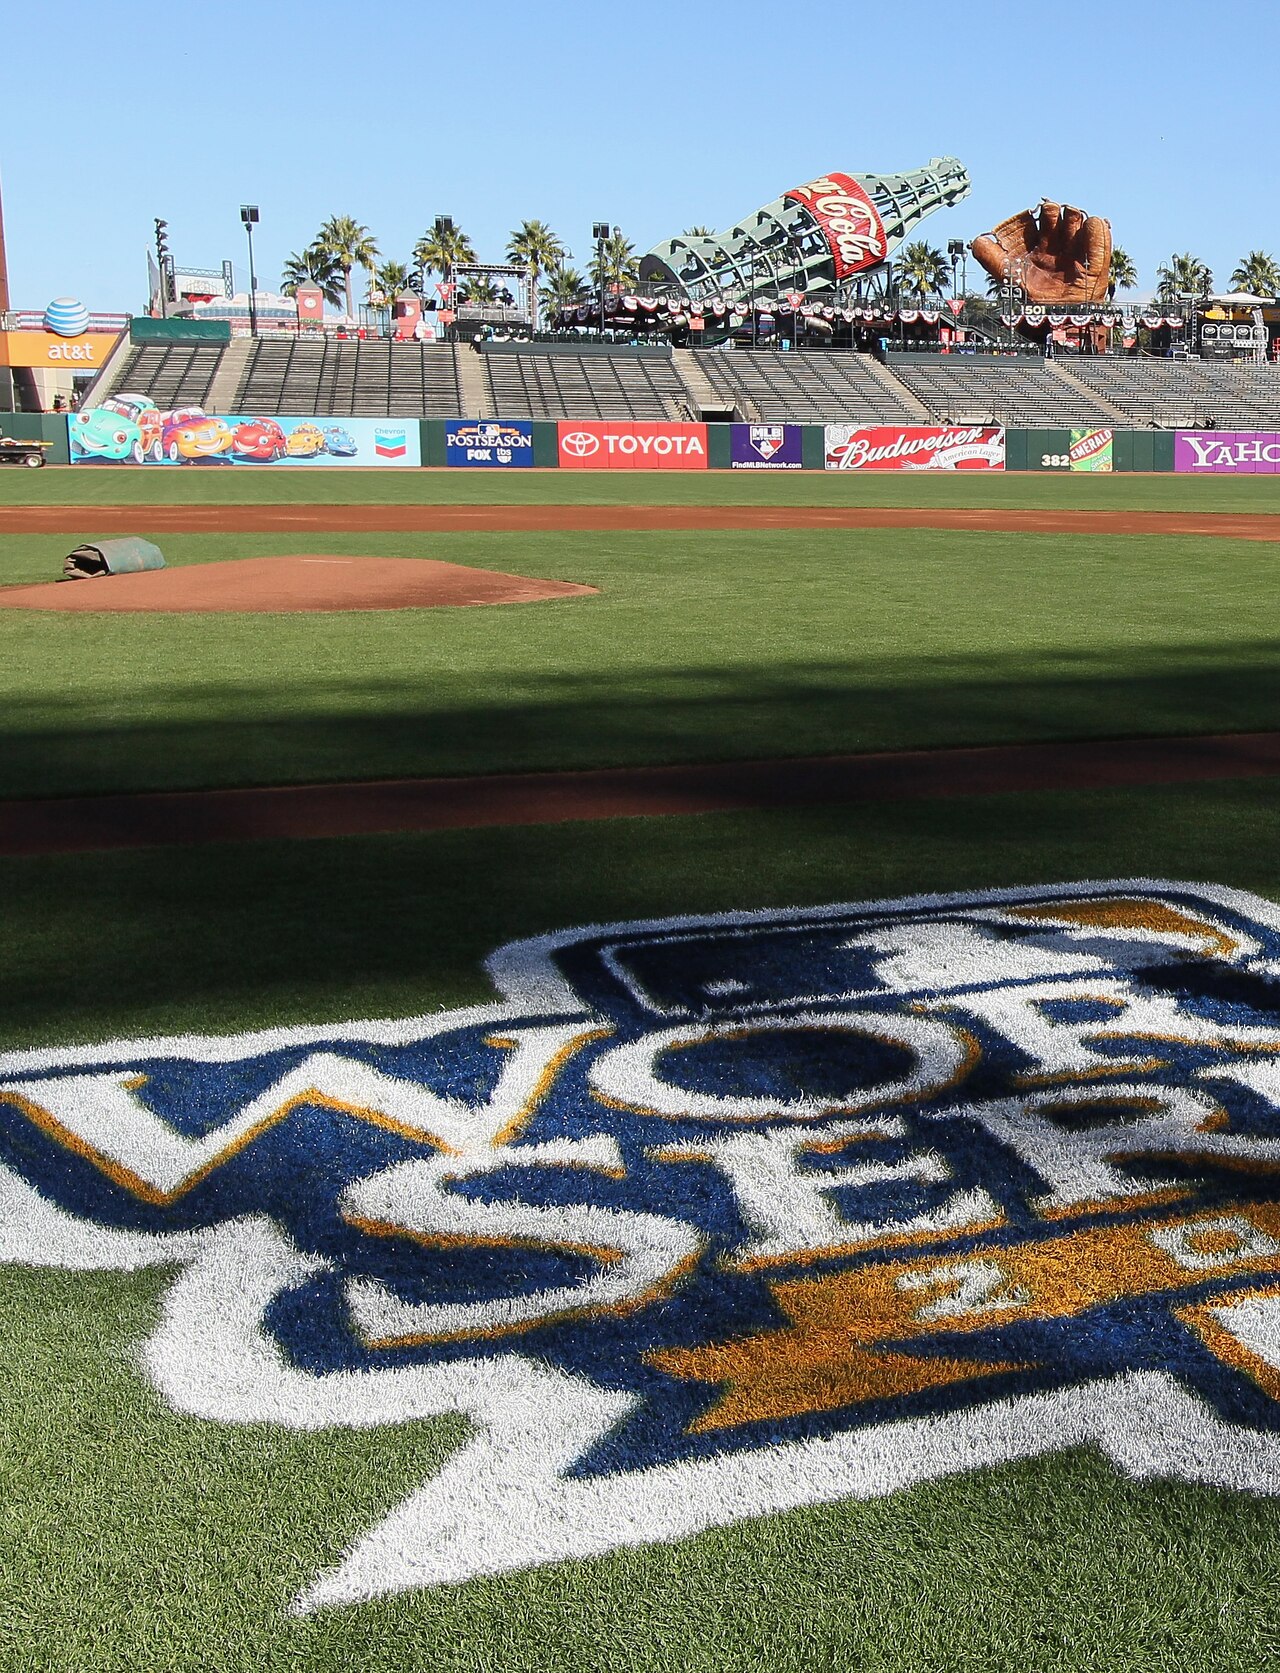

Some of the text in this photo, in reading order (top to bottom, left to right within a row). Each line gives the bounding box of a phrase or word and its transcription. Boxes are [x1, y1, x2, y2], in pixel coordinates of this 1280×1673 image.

[47, 342, 95, 360] at&t
[374, 427, 406, 435] Chevron
[752, 427, 782, 437] MLB
[446, 434, 532, 447] POSTSEASON
[603, 435, 704, 455] TOYOTA
[1070, 429, 1113, 460] EMERALD
[466, 449, 492, 461] FOX
[496, 447, 512, 456] tbs
[831, 427, 983, 470] Budweiser
[943, 448, 1001, 462] American Lager
[732, 461, 802, 469] FindMLBNetwork.com
[1041, 454, 1070, 467] 382
